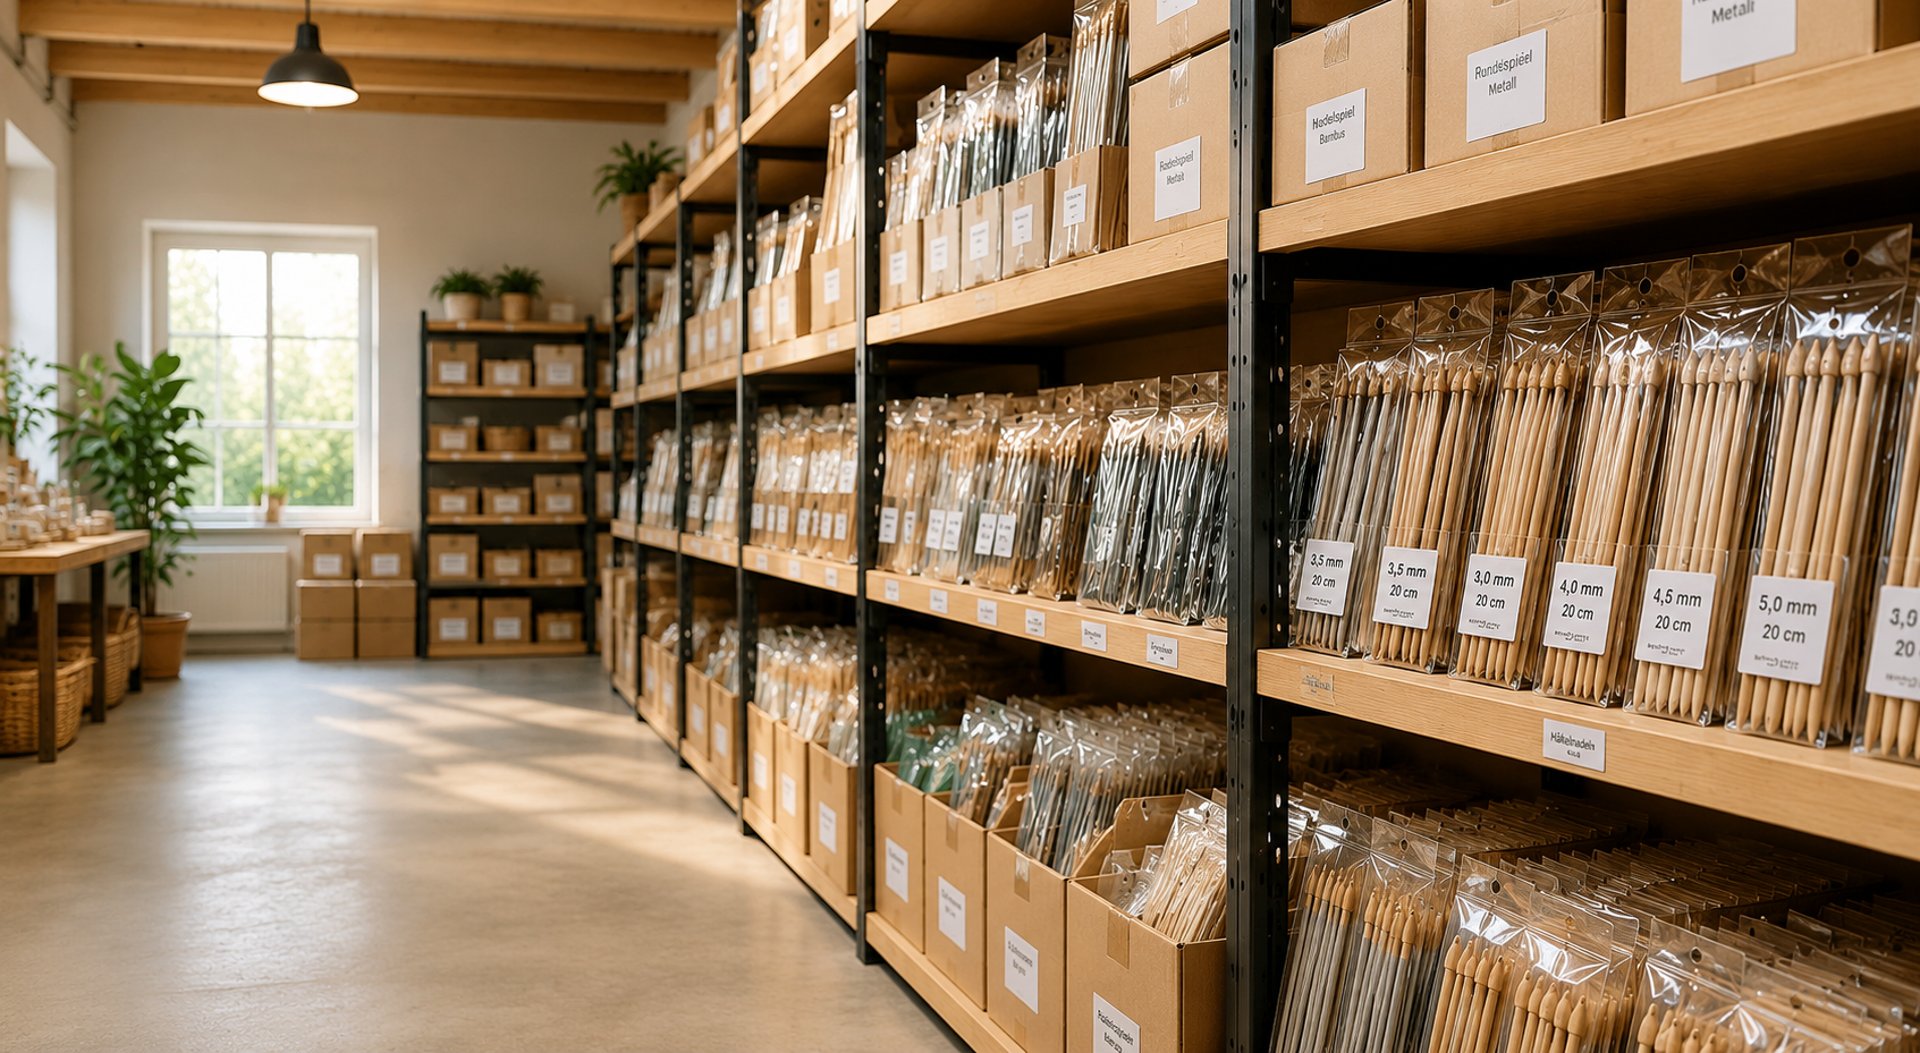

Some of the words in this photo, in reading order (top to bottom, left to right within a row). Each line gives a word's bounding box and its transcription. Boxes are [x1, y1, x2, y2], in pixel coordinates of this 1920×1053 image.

[1488, 76, 1517, 96] Metall
[1311, 553, 1324, 567] 3,5
[1325, 557, 1344, 568] mm
[1387, 562, 1404, 577] 3,5
[1406, 567, 1427, 578] mm
[1473, 570, 1491, 586] 3,0
[1493, 575, 1515, 587] mm
[1312, 574, 1322, 586] 20
[1323, 578, 1336, 588] cm
[1560, 579, 1578, 596] 4,0
[1580, 584, 1604, 597] mm
[1389, 584, 1402, 597] 20
[1403, 588, 1418, 599] cm
[1653, 588, 1674, 606] 4,5
[1676, 593, 1702, 607] mm
[1475, 593, 1488, 607] 20
[1489, 598, 1505, 609] cm
[1759, 594, 1783, 616] 5,0
[1786, 600, 1817, 616] mm
[1561, 603, 1576, 618] 20
[1577, 609, 1594, 621] cm
[1655, 614, 1670, 630] 20
[1672, 620, 1692, 632] cm
[1762, 623, 1780, 640] 20
[1783, 629, 1806, 644] cm
[1894, 639, 1916, 658] 20
